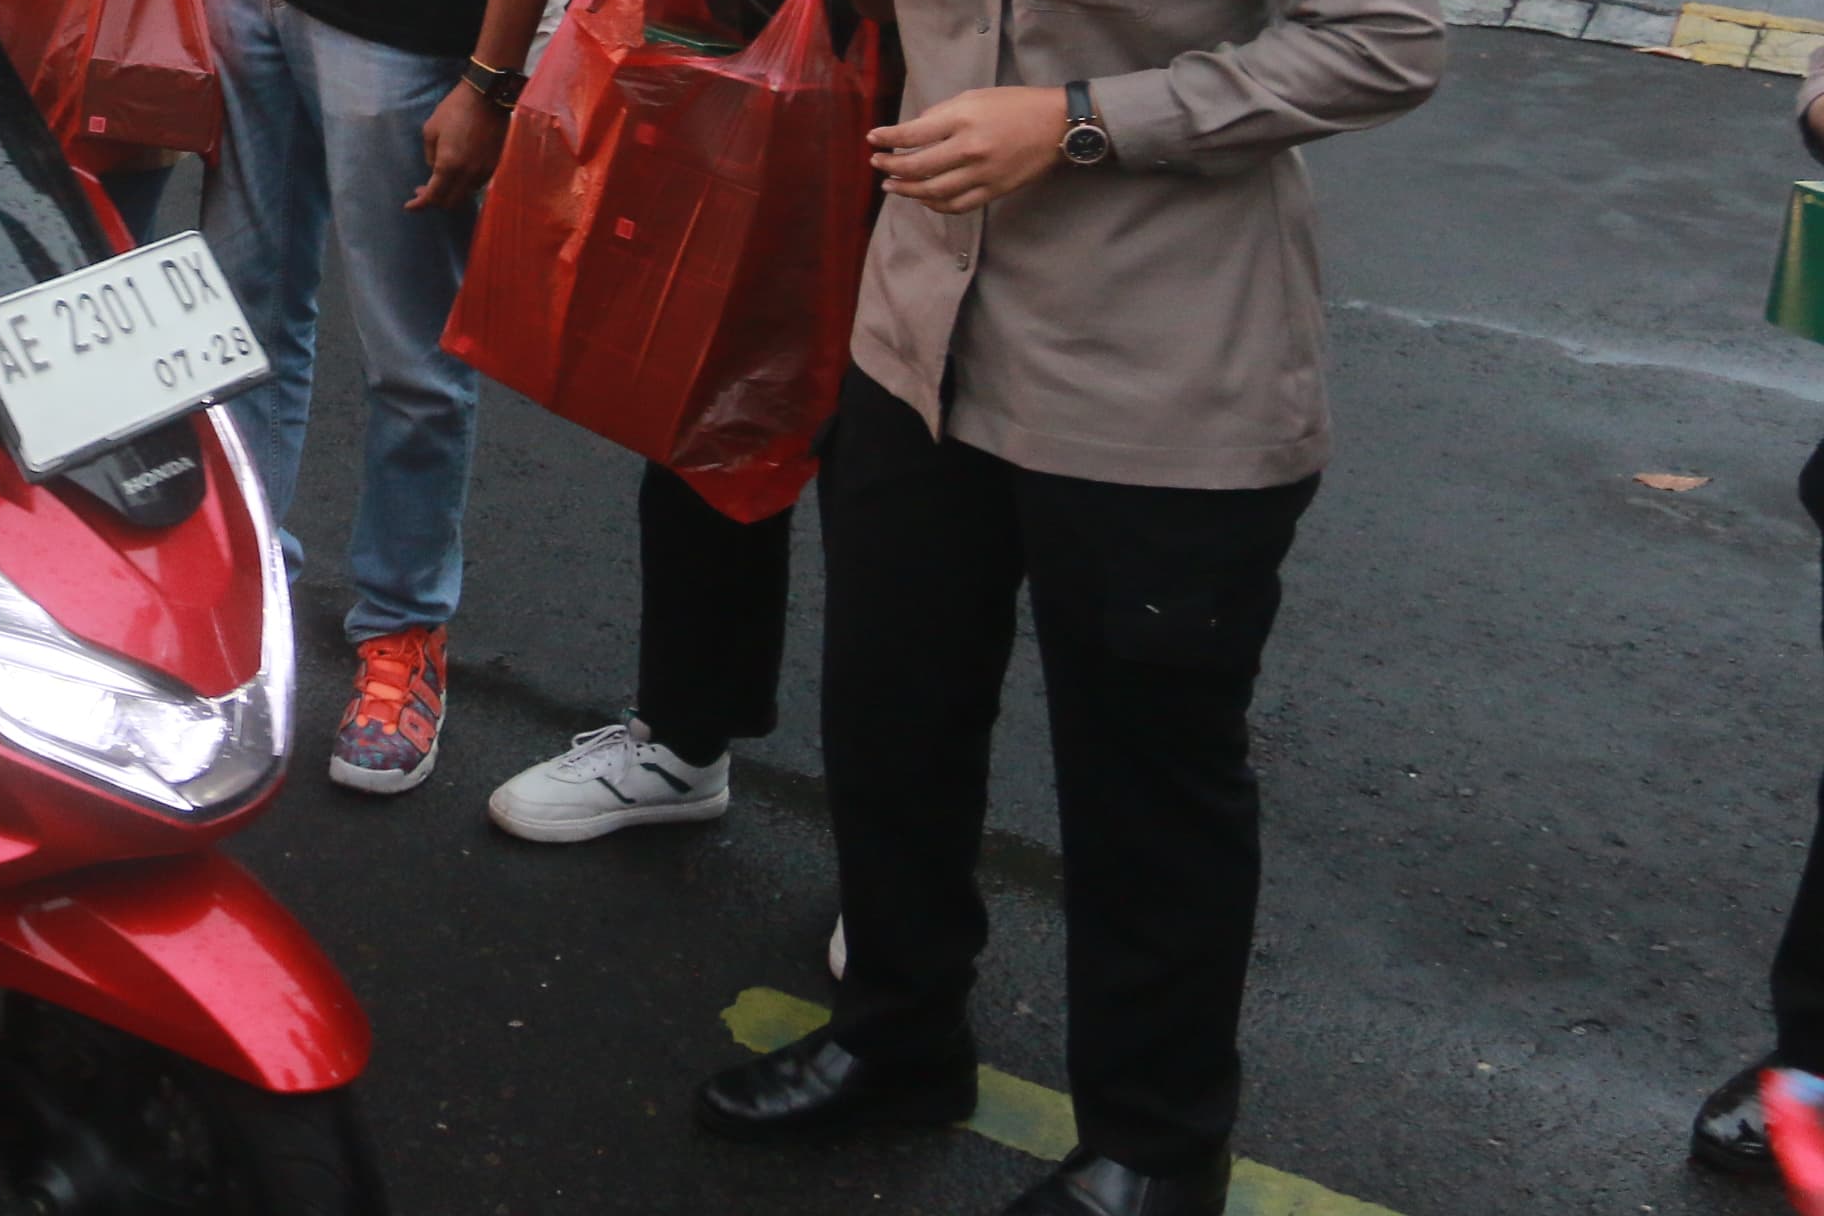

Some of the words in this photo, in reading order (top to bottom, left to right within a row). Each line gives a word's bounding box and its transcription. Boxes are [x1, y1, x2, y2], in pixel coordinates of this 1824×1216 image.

[53, 276, 159, 355] 2301
[160, 250, 223, 315] DX
[121, 456, 197, 496] HONDA
